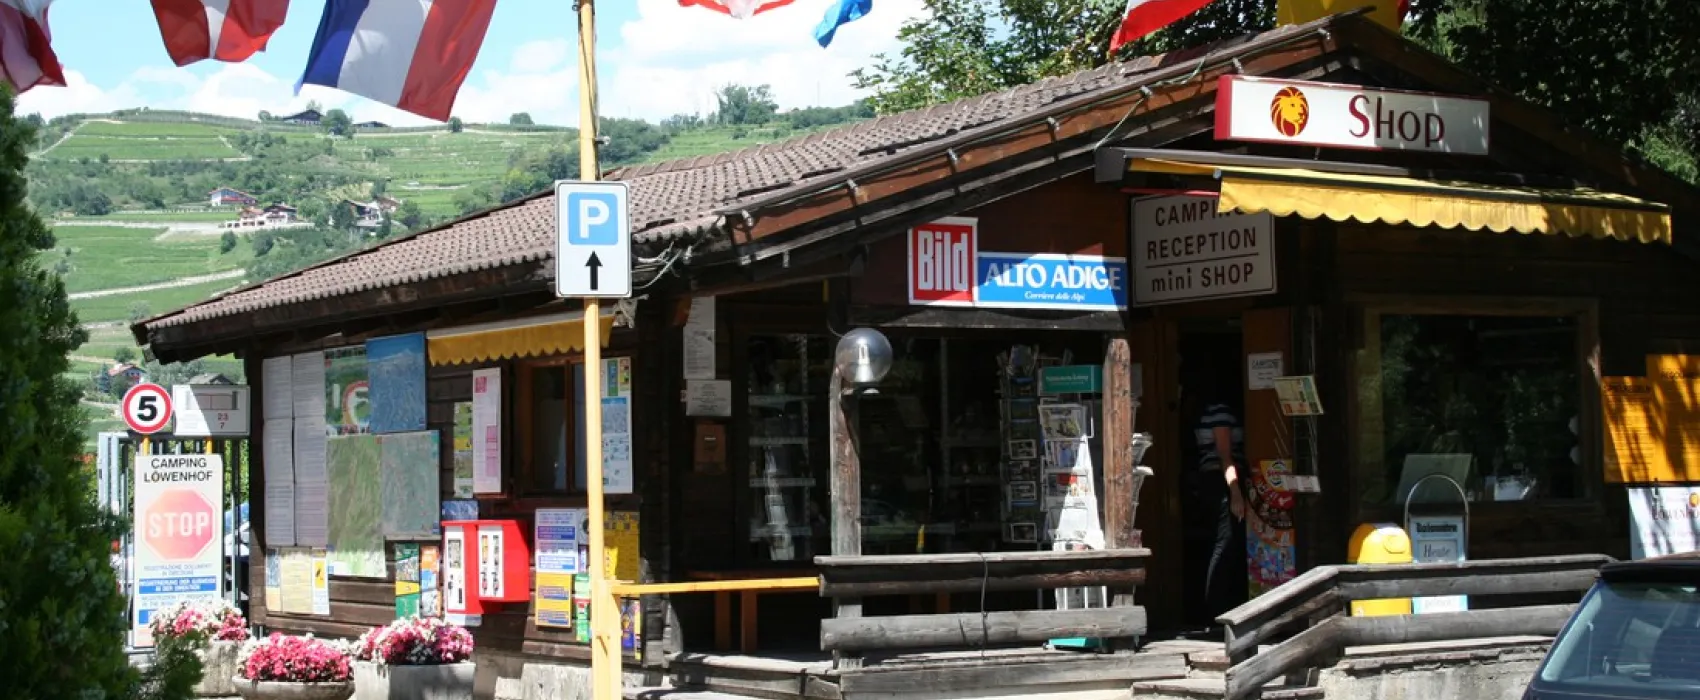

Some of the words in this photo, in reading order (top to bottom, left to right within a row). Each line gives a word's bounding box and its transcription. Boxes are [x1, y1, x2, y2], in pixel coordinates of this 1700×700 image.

[579, 198, 611, 240] P
[1155, 199, 1244, 227] CAMPI
[1147, 226, 1257, 261] RECEPTION
[917, 229, 968, 291] Bild
[983, 262, 1047, 289] ALTO
[1050, 264, 1122, 291] ADIGE
[1151, 267, 1193, 293] mini
[1201, 262, 1254, 289] SHOP
[136, 395, 158, 422] 5
[143, 470, 213, 483] LÖWENHOF
[151, 457, 208, 470] CAMPING
[148, 511, 209, 538] STOP
